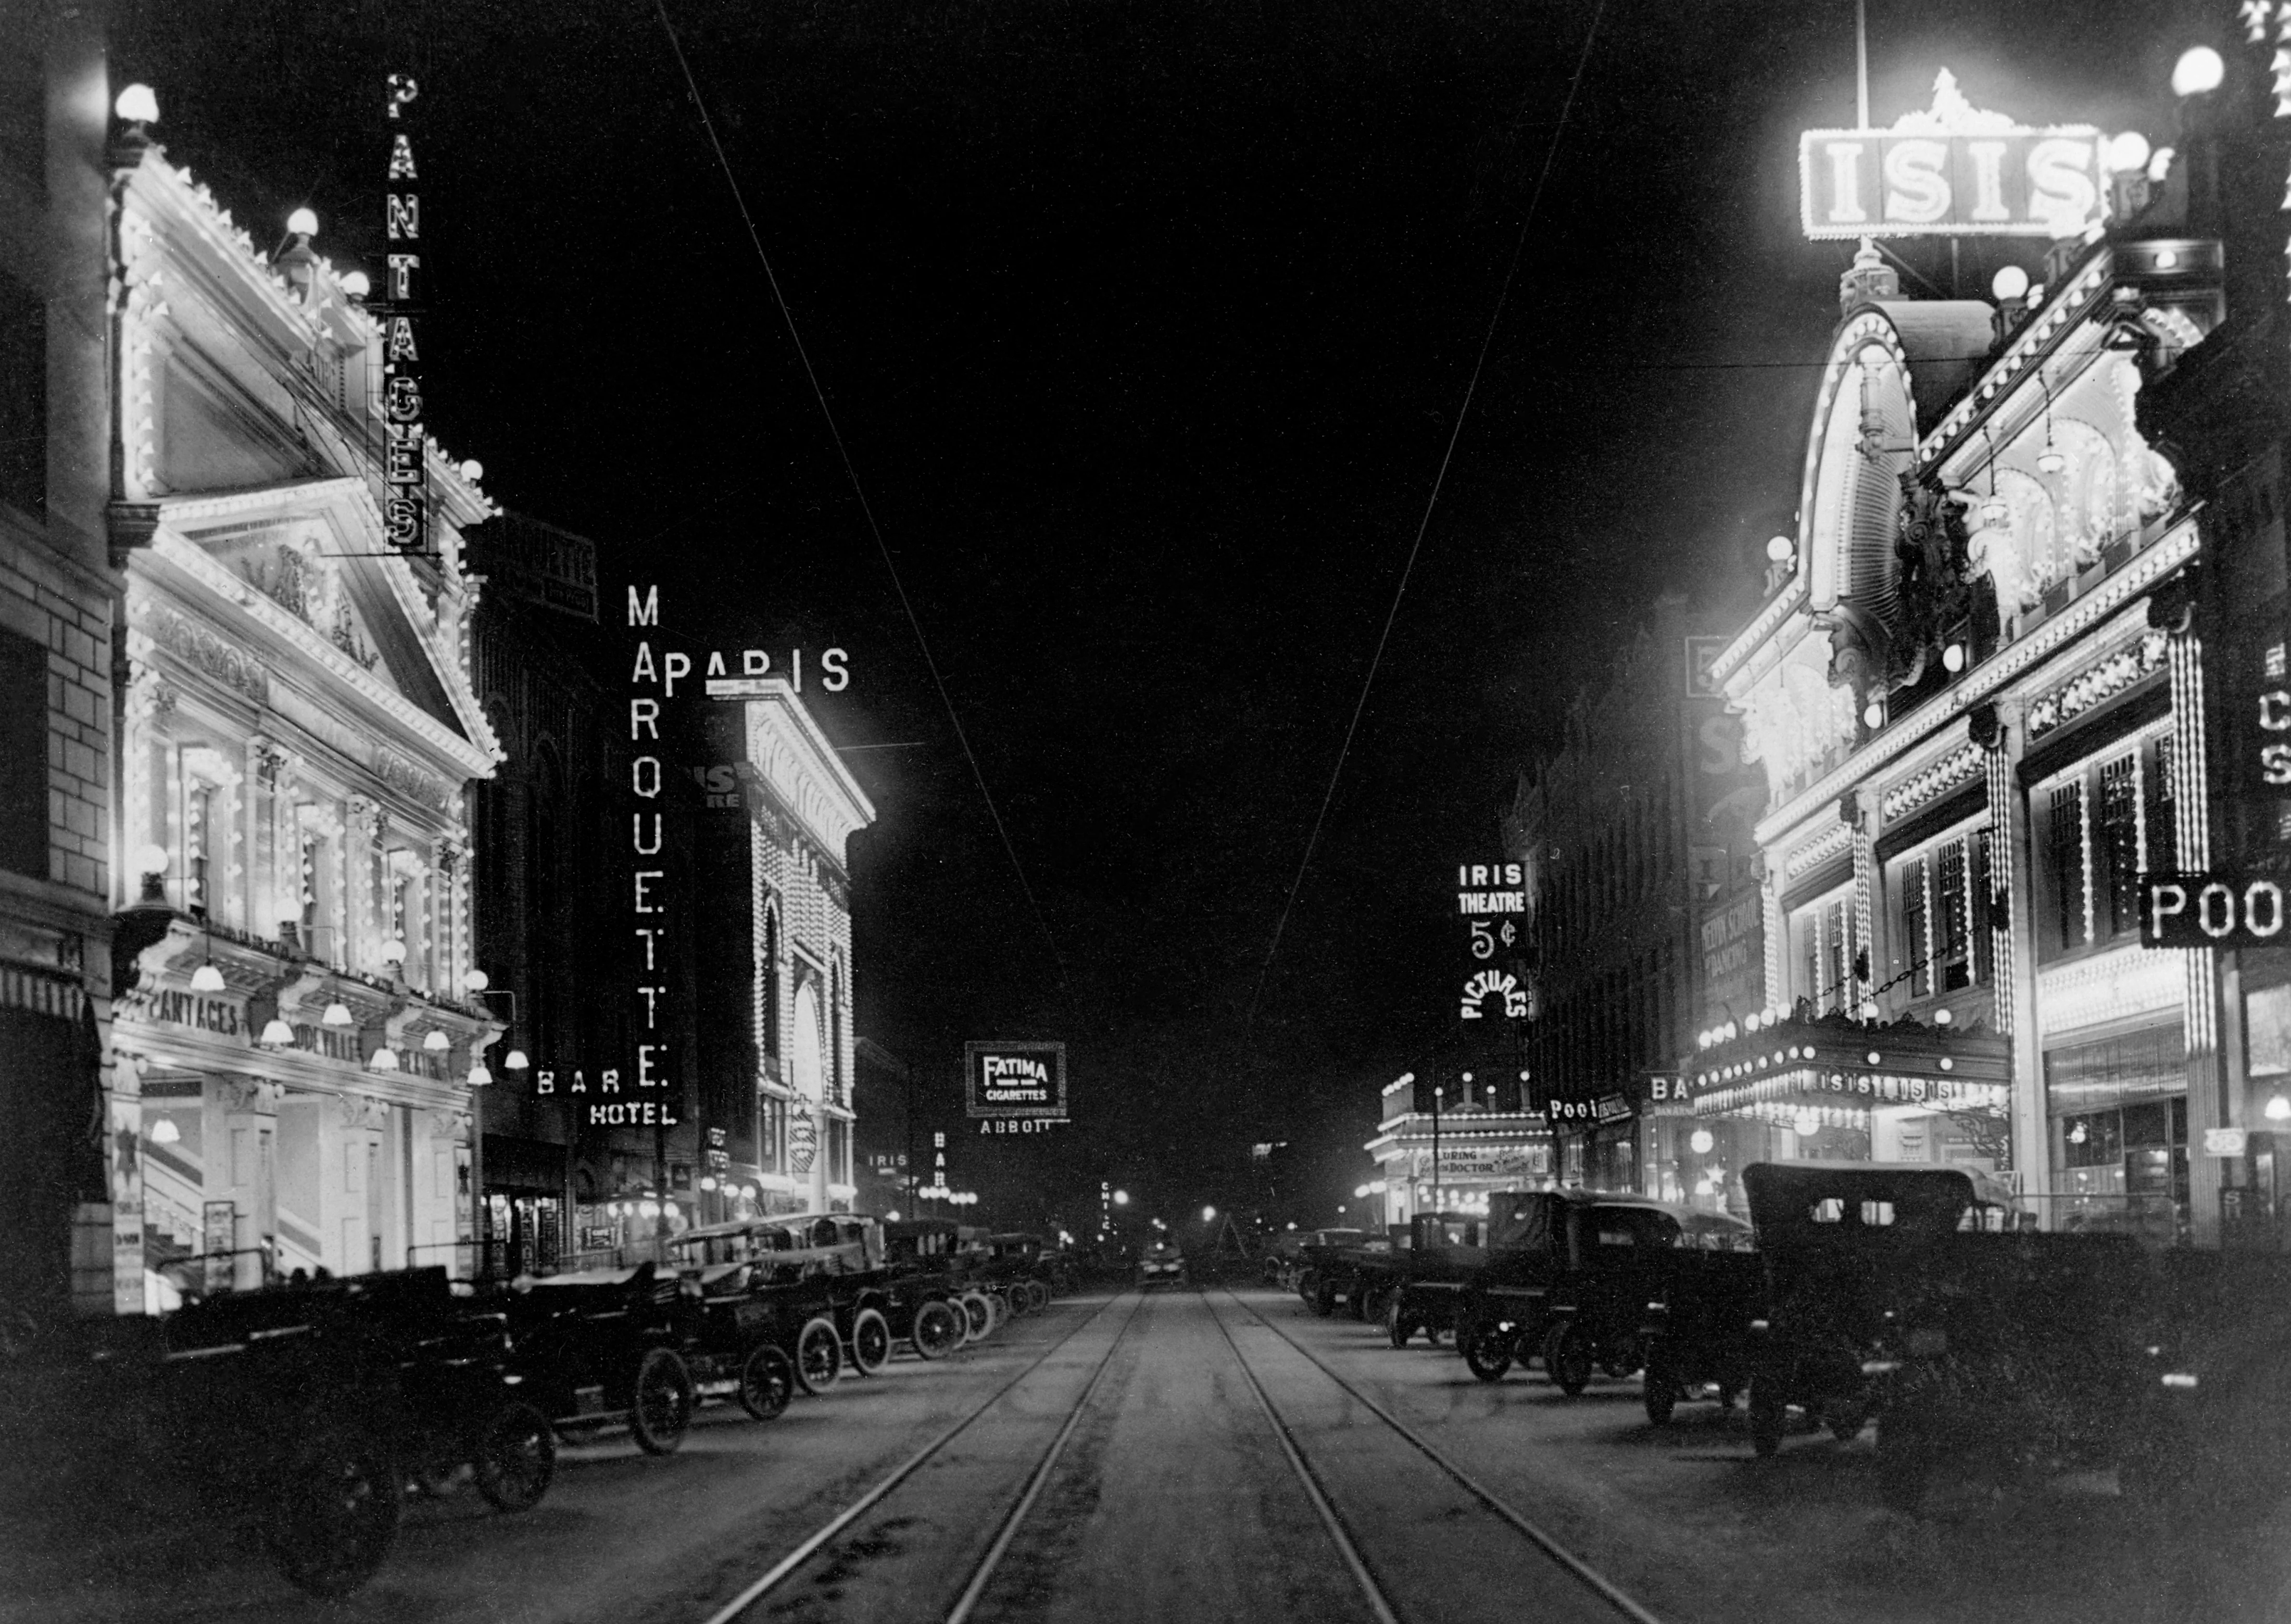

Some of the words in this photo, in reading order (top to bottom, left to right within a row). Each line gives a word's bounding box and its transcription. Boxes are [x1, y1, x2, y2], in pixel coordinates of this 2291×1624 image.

[1826, 138, 2096, 223] ISIS
[386, 73, 423, 548] PANTAGES
[628, 584, 668, 1087] MARQUETTE
[1459, 864, 1522, 885] IRIS
[1459, 892, 1525, 914] THEATRE
[1461, 970, 1527, 1019] PICTURES
[537, 1069, 620, 1094] BAR
[984, 1055, 1048, 1087] FATIMA
[986, 1089, 1048, 1101] CIGARETTES
[1651, 1076, 1690, 1100] BA
[590, 1102, 677, 1125] HOTEL
[980, 1119, 1057, 1135] ABBOTT
[868, 1154, 907, 1166] IRIS
[934, 1131, 946, 1187] BAR
[1437, 1151, 1477, 1161] URING
